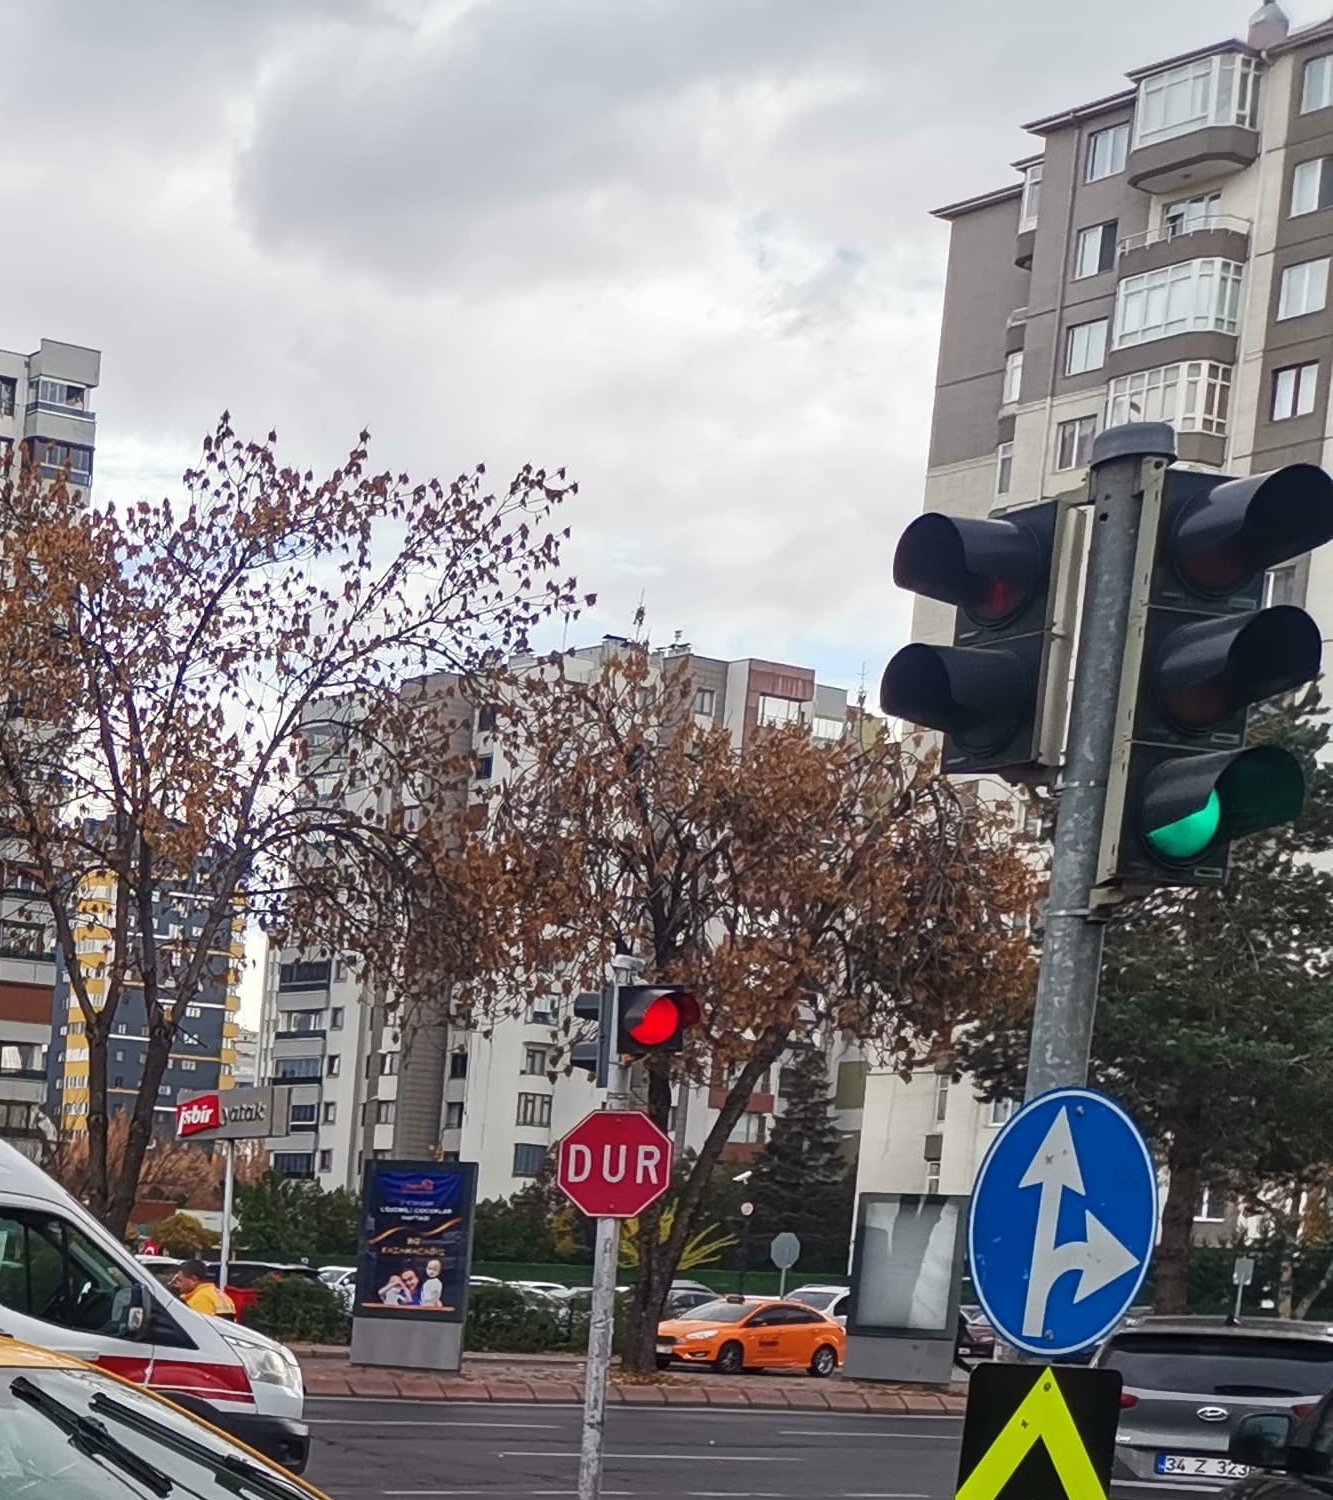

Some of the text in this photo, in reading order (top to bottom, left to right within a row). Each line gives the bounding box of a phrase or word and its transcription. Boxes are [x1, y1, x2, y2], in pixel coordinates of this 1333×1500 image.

[567, 1144, 661, 1184] DUR
[1166, 1457, 1185, 1472] 34
[1194, 1459, 1207, 1474] Z
